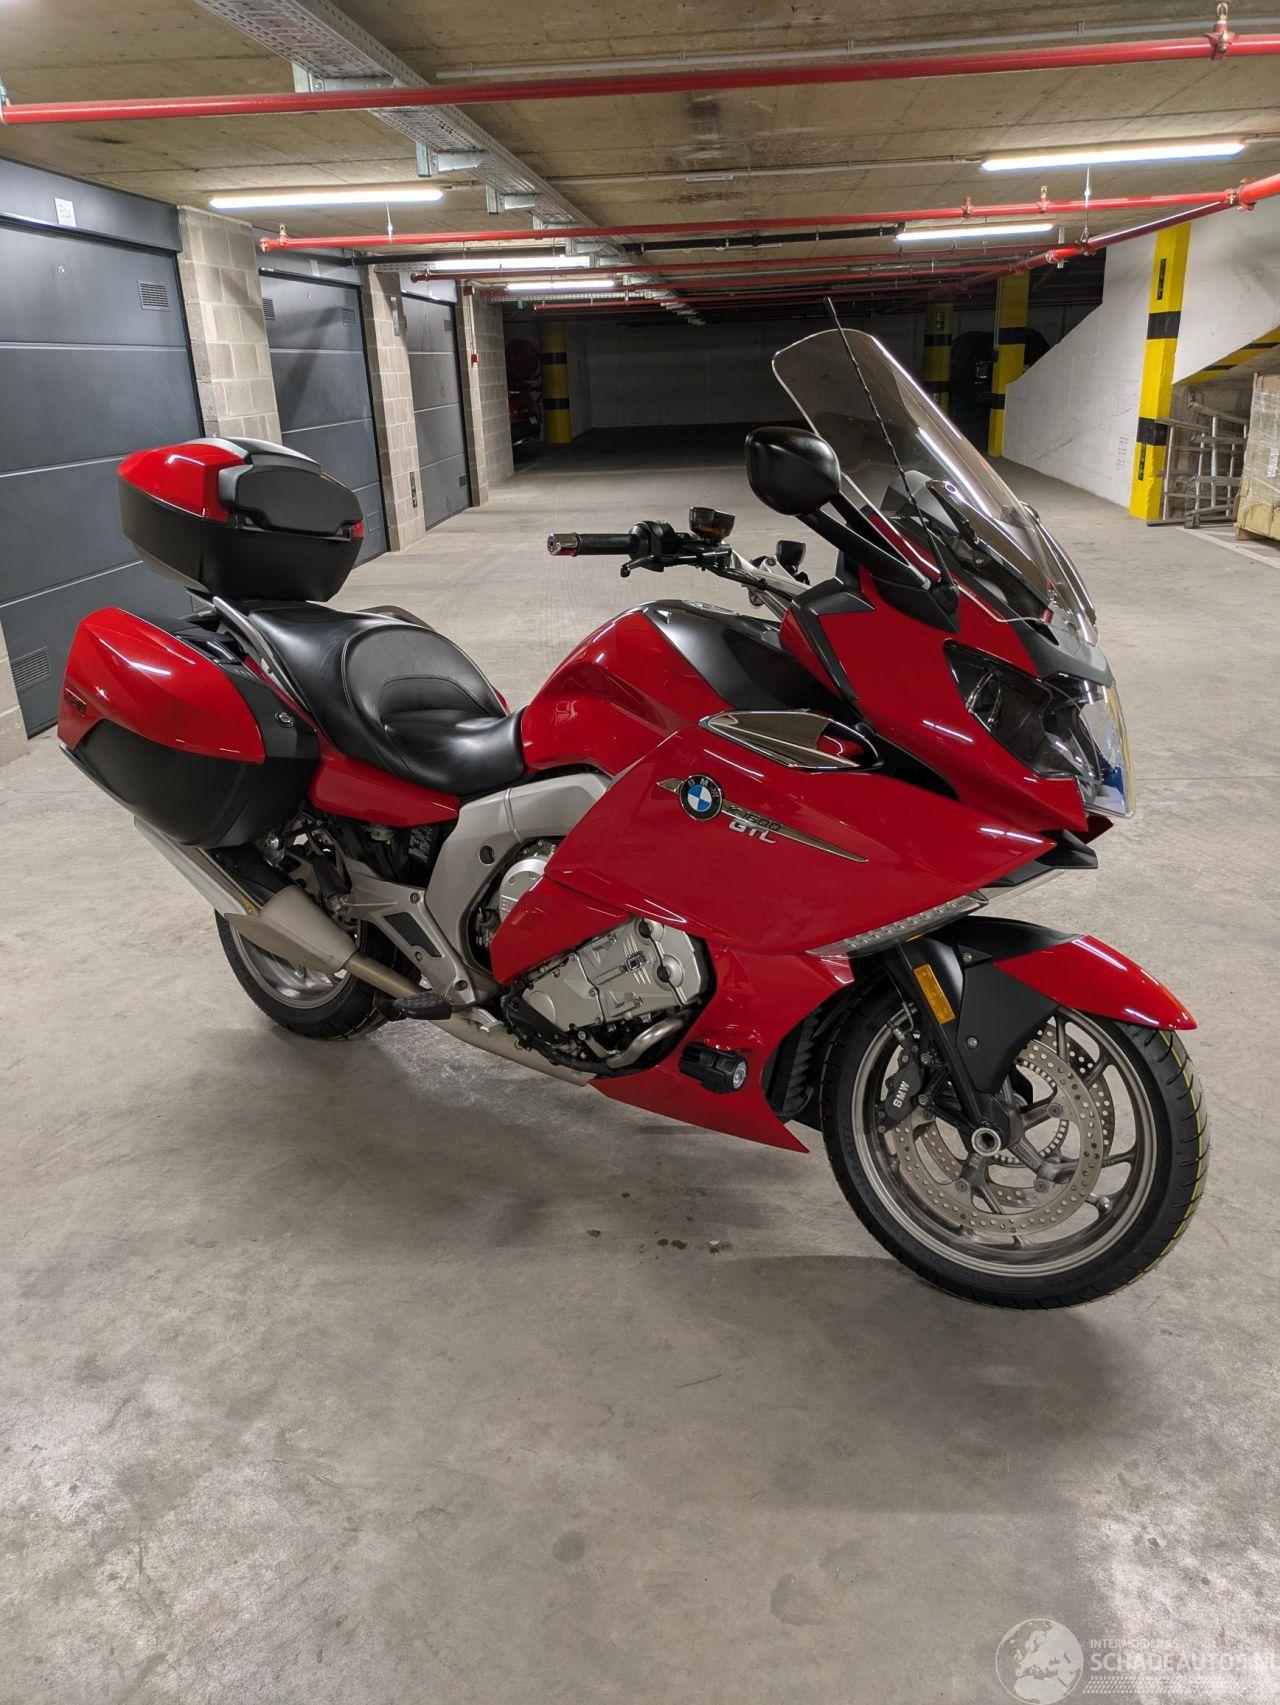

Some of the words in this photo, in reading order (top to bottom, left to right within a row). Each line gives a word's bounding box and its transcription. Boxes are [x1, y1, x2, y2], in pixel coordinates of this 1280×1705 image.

[688, 778, 719, 798] BMW
[729, 820, 776, 844] GTL
[893, 1080, 910, 1108] BMW
